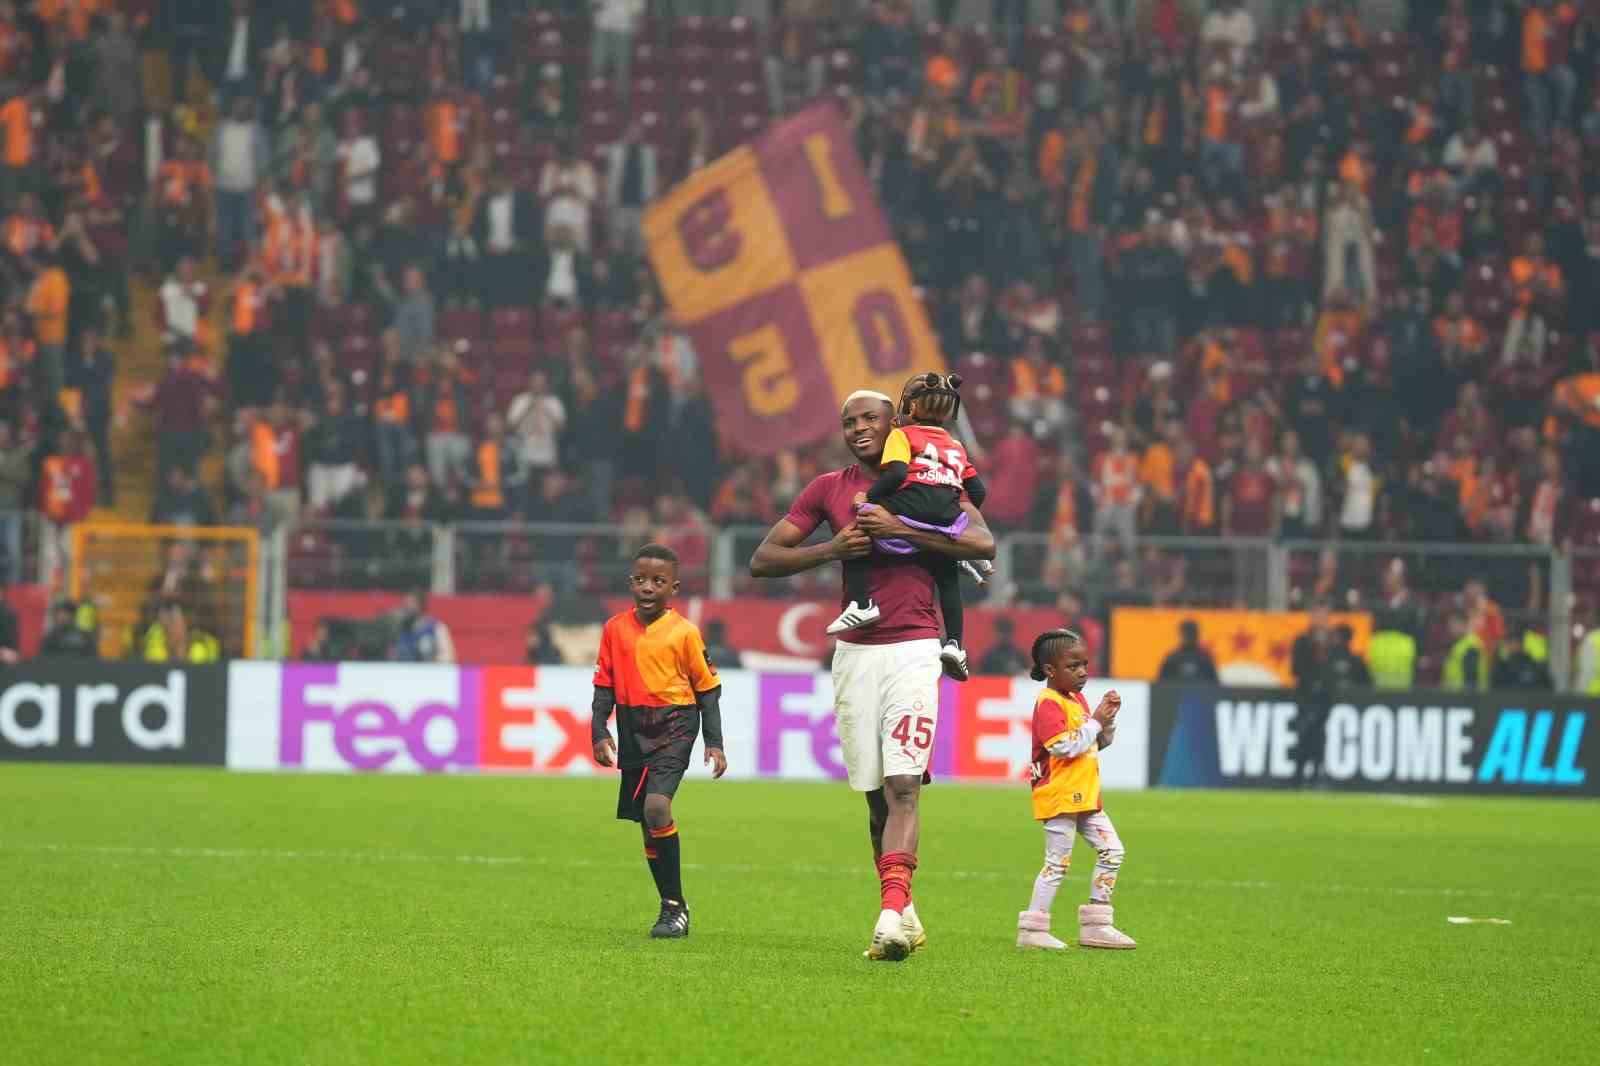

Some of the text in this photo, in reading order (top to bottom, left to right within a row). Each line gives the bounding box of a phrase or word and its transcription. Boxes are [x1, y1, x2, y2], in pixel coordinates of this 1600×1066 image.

[891, 714, 934, 749] 45
[1215, 700, 1587, 785] WECOME ALL
